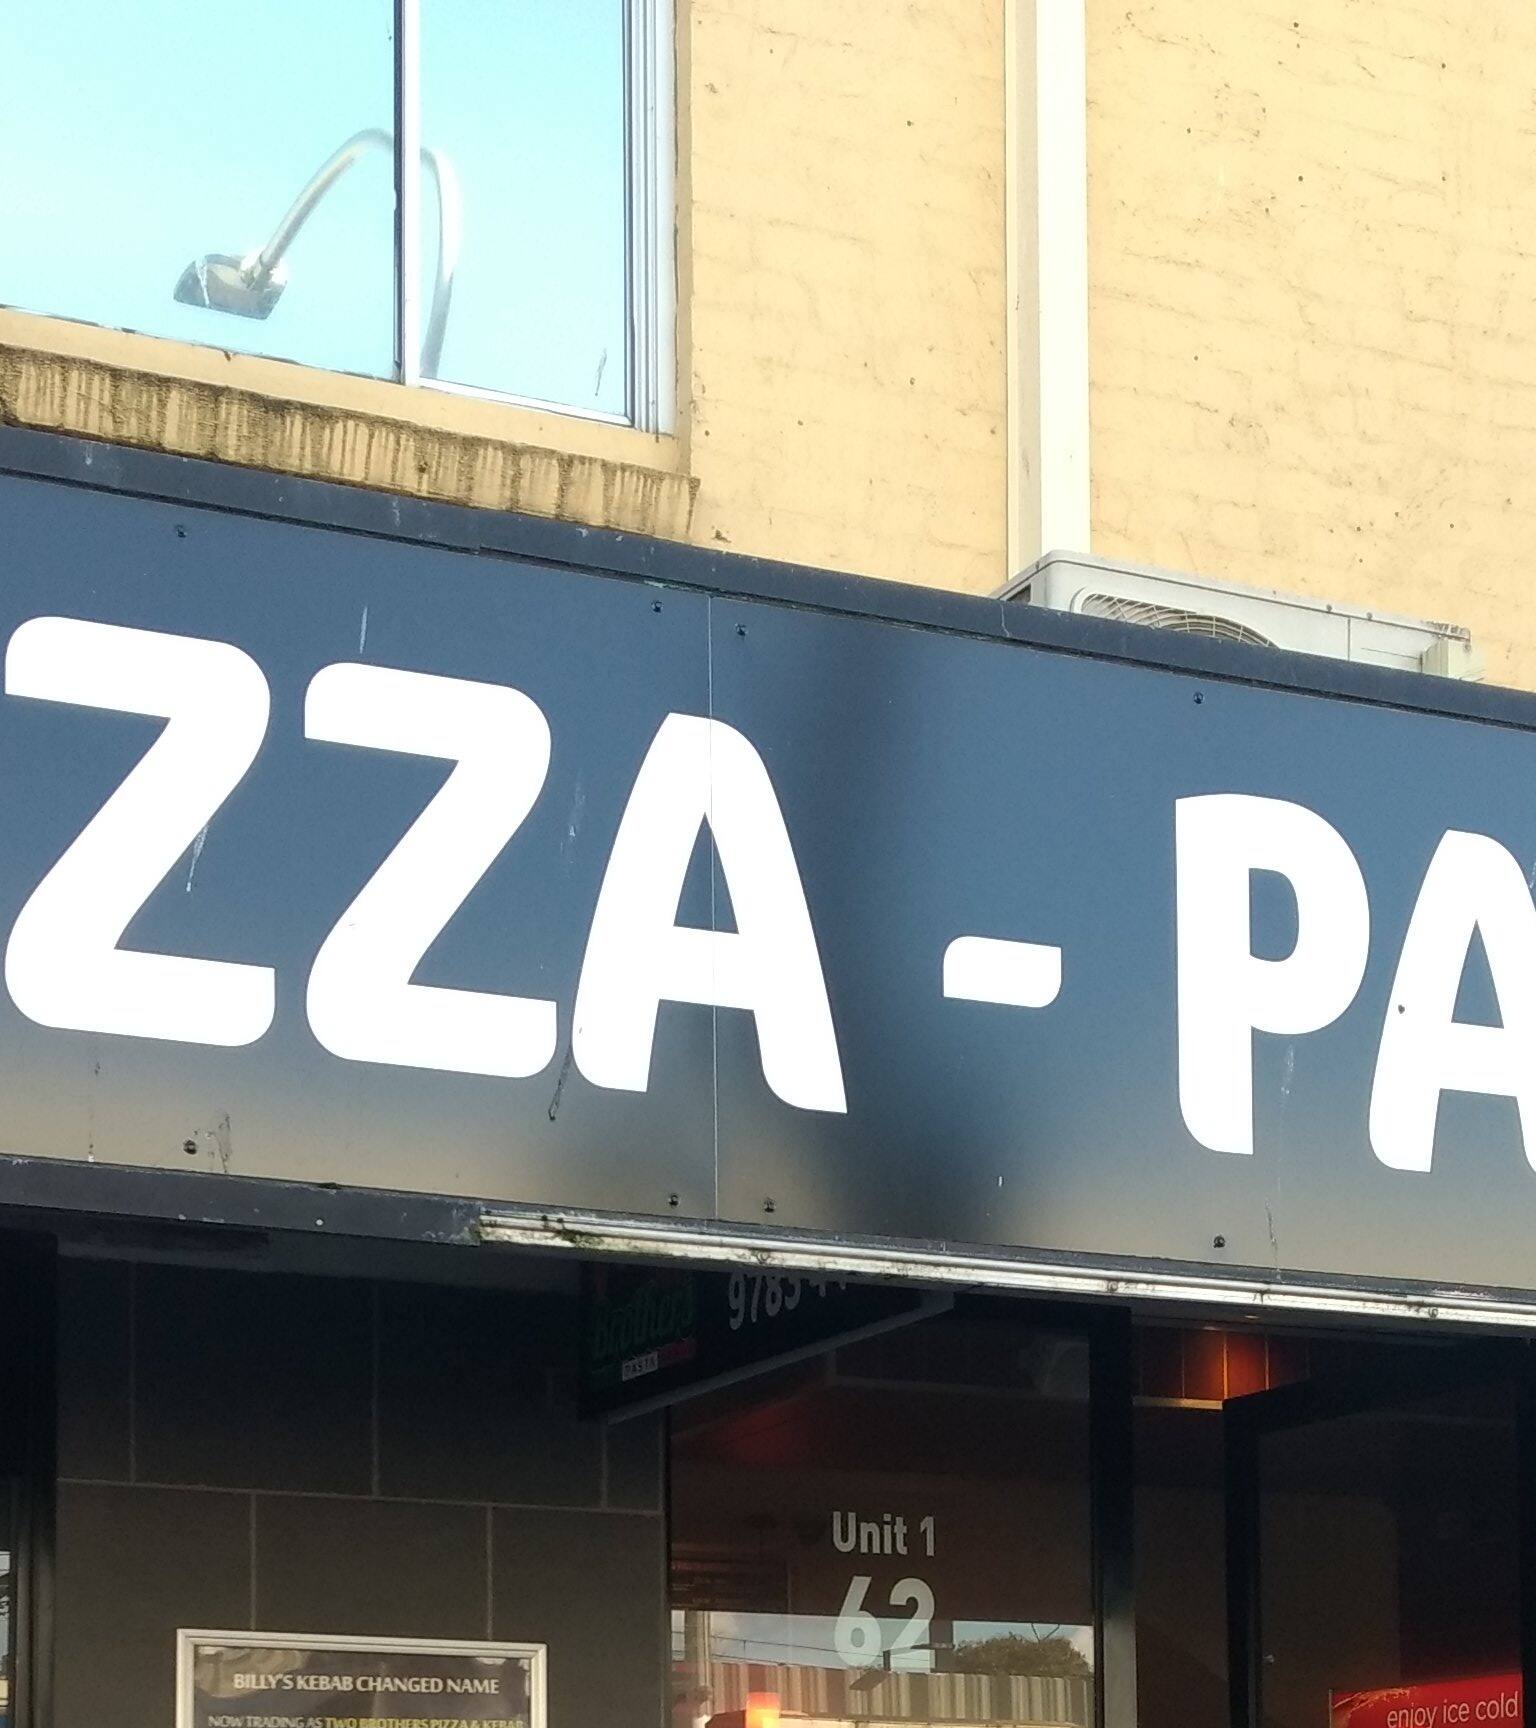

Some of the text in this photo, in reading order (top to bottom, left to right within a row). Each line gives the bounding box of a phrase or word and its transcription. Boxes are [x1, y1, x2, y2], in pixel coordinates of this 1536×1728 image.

[832, 1510, 936, 1557] Unit 1
[833, 1575, 936, 1673] 62
[233, 1673, 500, 1694] BILLY'S KEBAB CHANGED NAME
[208, 1715, 242, 1728] NOW
[246, 1716, 305, 1728] TRADING
[307, 1717, 323, 1728] AS
[1442, 1699, 1470, 1724] ice
[1475, 1690, 1519, 1721] cold
